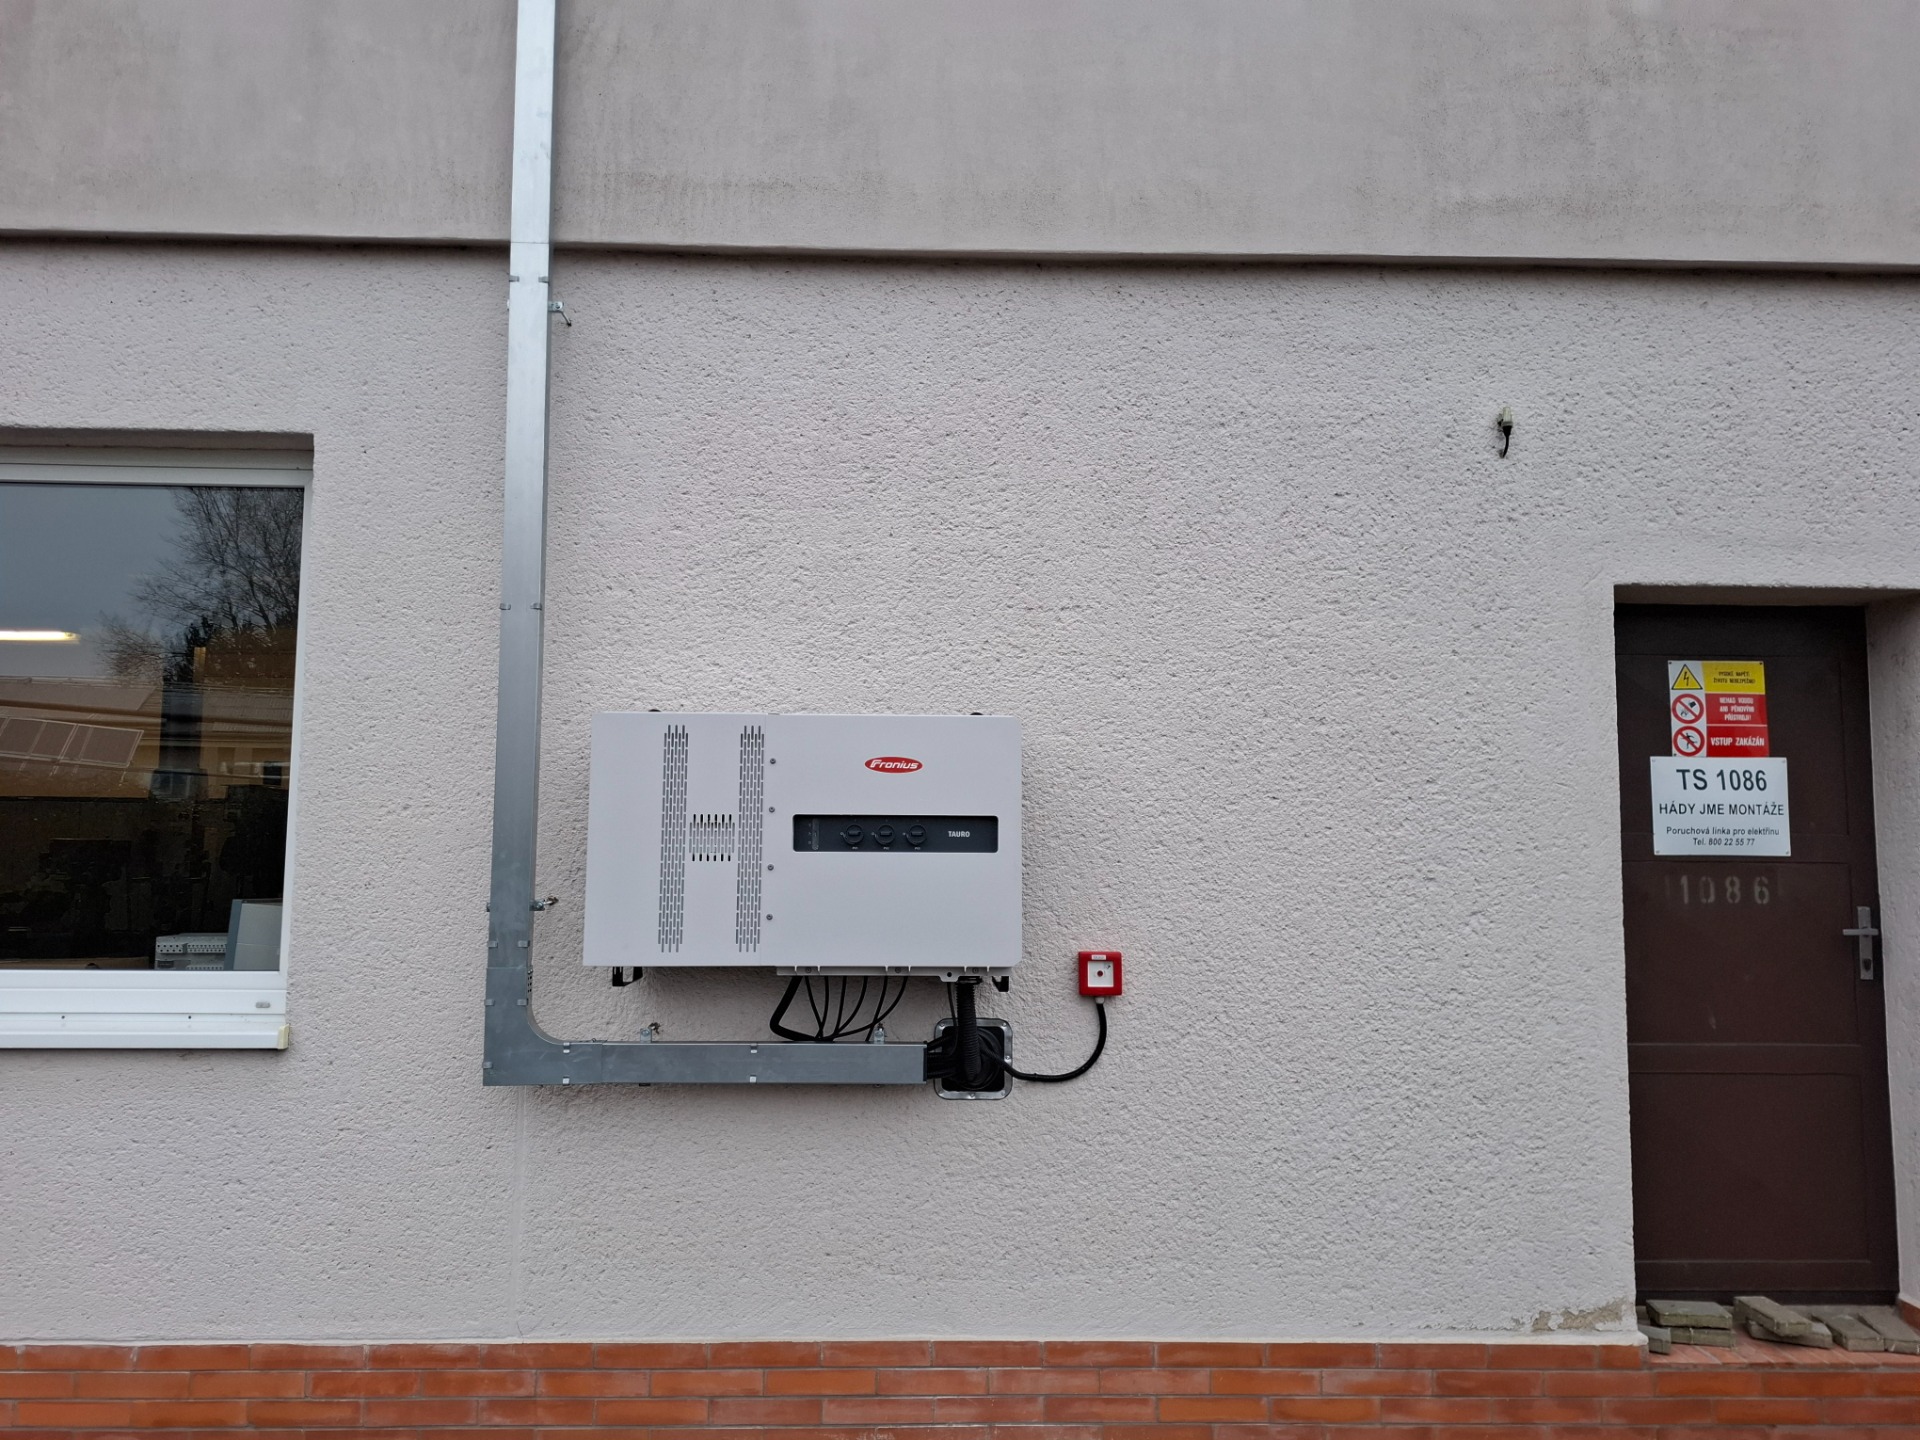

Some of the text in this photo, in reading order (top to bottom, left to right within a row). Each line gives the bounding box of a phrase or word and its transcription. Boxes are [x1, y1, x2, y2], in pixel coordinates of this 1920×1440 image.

[1710, 736, 1765, 746] VSTUP ZAKÁZÁN
[868, 758, 919, 770] Fronius
[1676, 769, 1767, 791] TS 1086
[1659, 800, 1785, 816] HÁDY JME MONTÁŽE
[947, 830, 971, 838] TAURO
[1666, 826, 1780, 837] Poruchová linka pro elektřinu
[1693, 838, 1755, 846] Tel. 800 22 55 77
[1680, 875, 1769, 905] 1086
